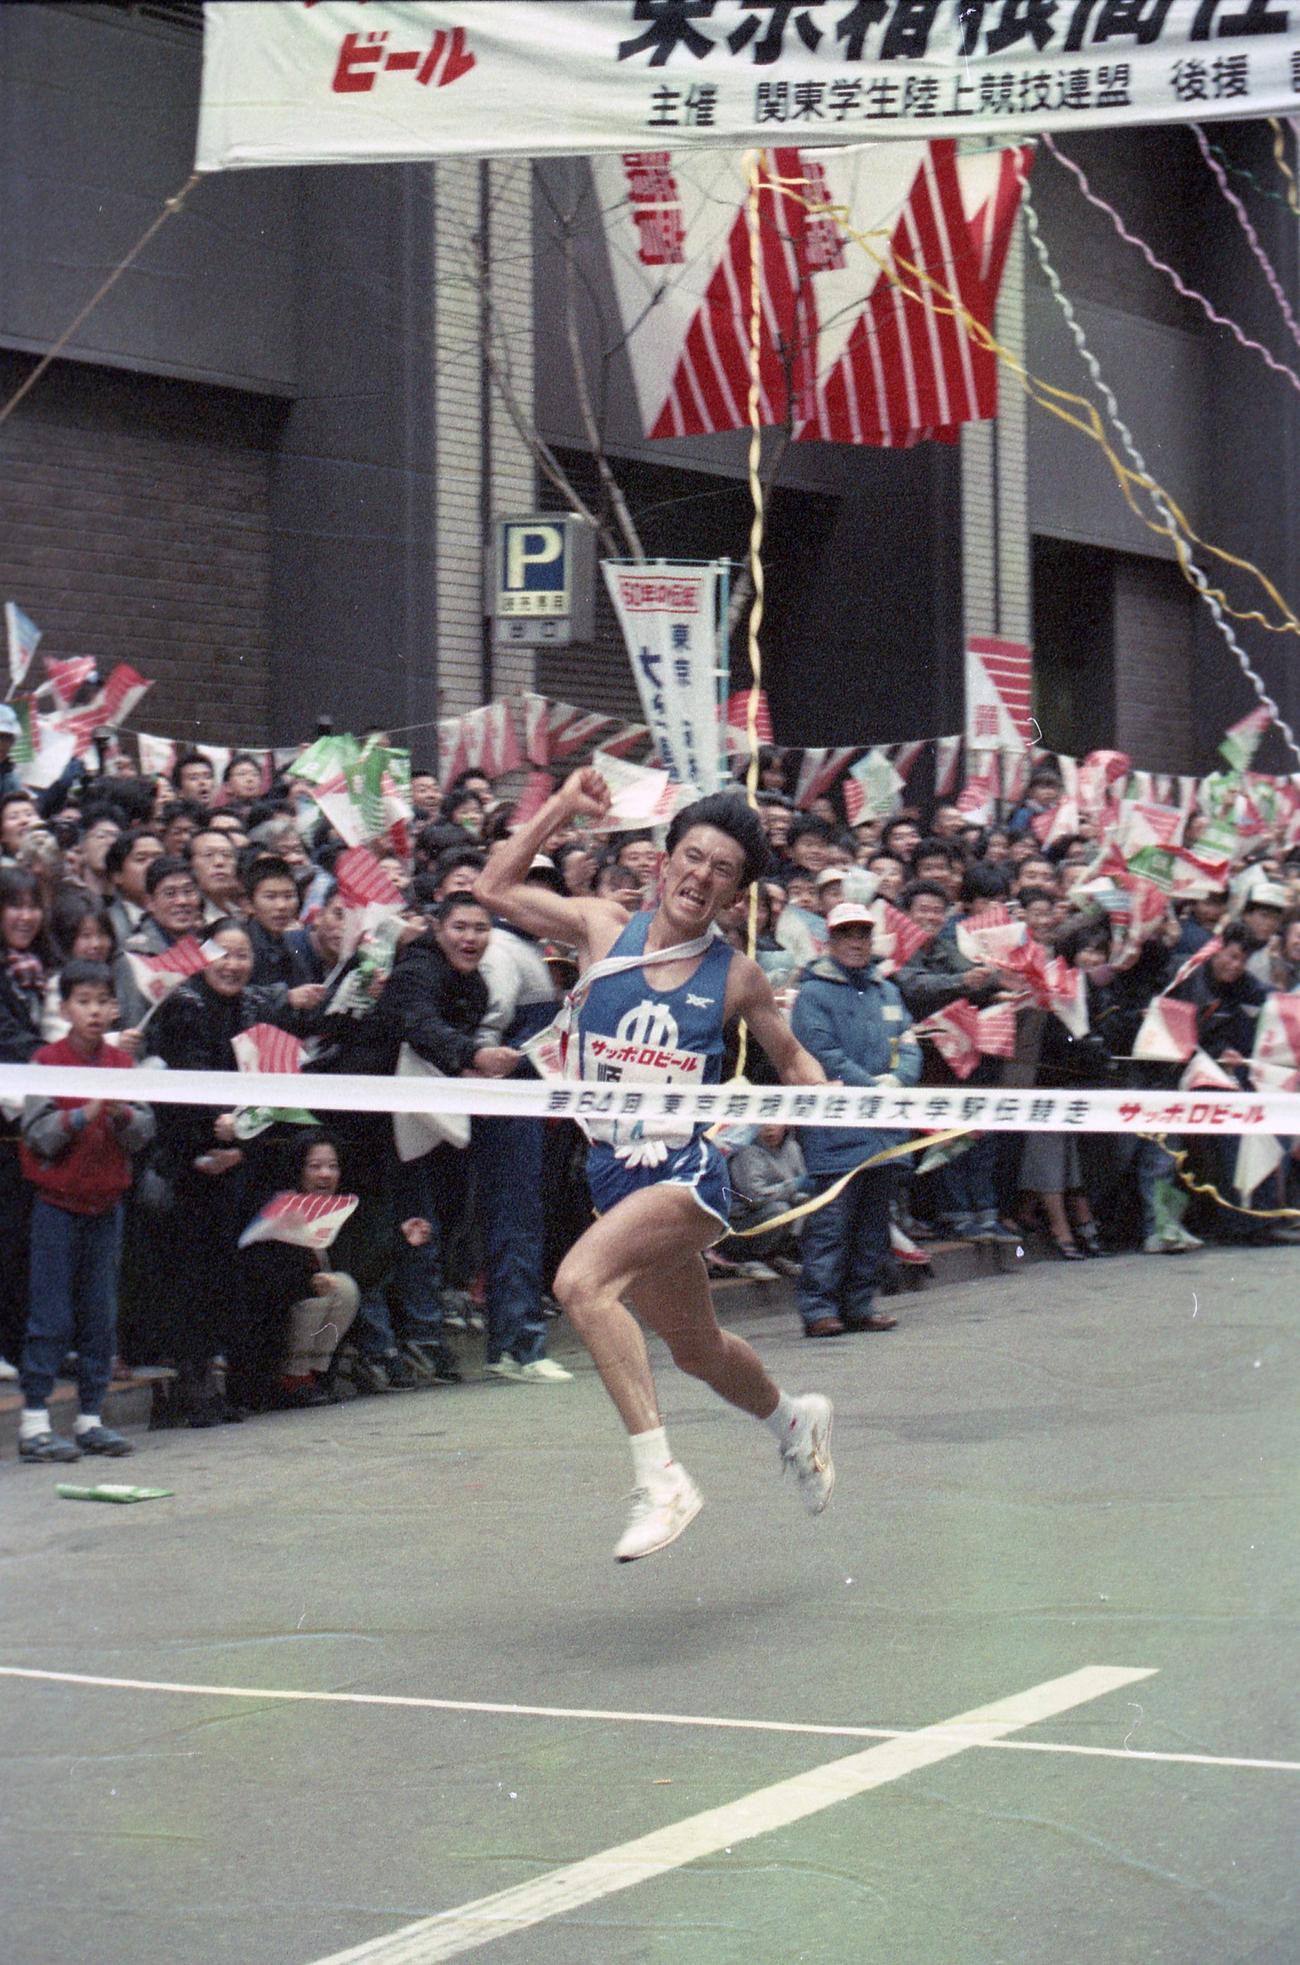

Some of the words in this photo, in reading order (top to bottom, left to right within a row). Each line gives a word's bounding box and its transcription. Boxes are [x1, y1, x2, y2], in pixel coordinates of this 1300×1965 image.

[332, 26, 476, 93] ビール
[647, 84, 718, 126] 主催
[755, 62, 1132, 123] 関東学生陸上競技連盟
[1170, 53, 1249, 101] 後援
[507, 526, 563, 589] P
[591, 1040, 698, 1072] サッポロビール
[1118, 1103, 1265, 1125] サッポロビール
